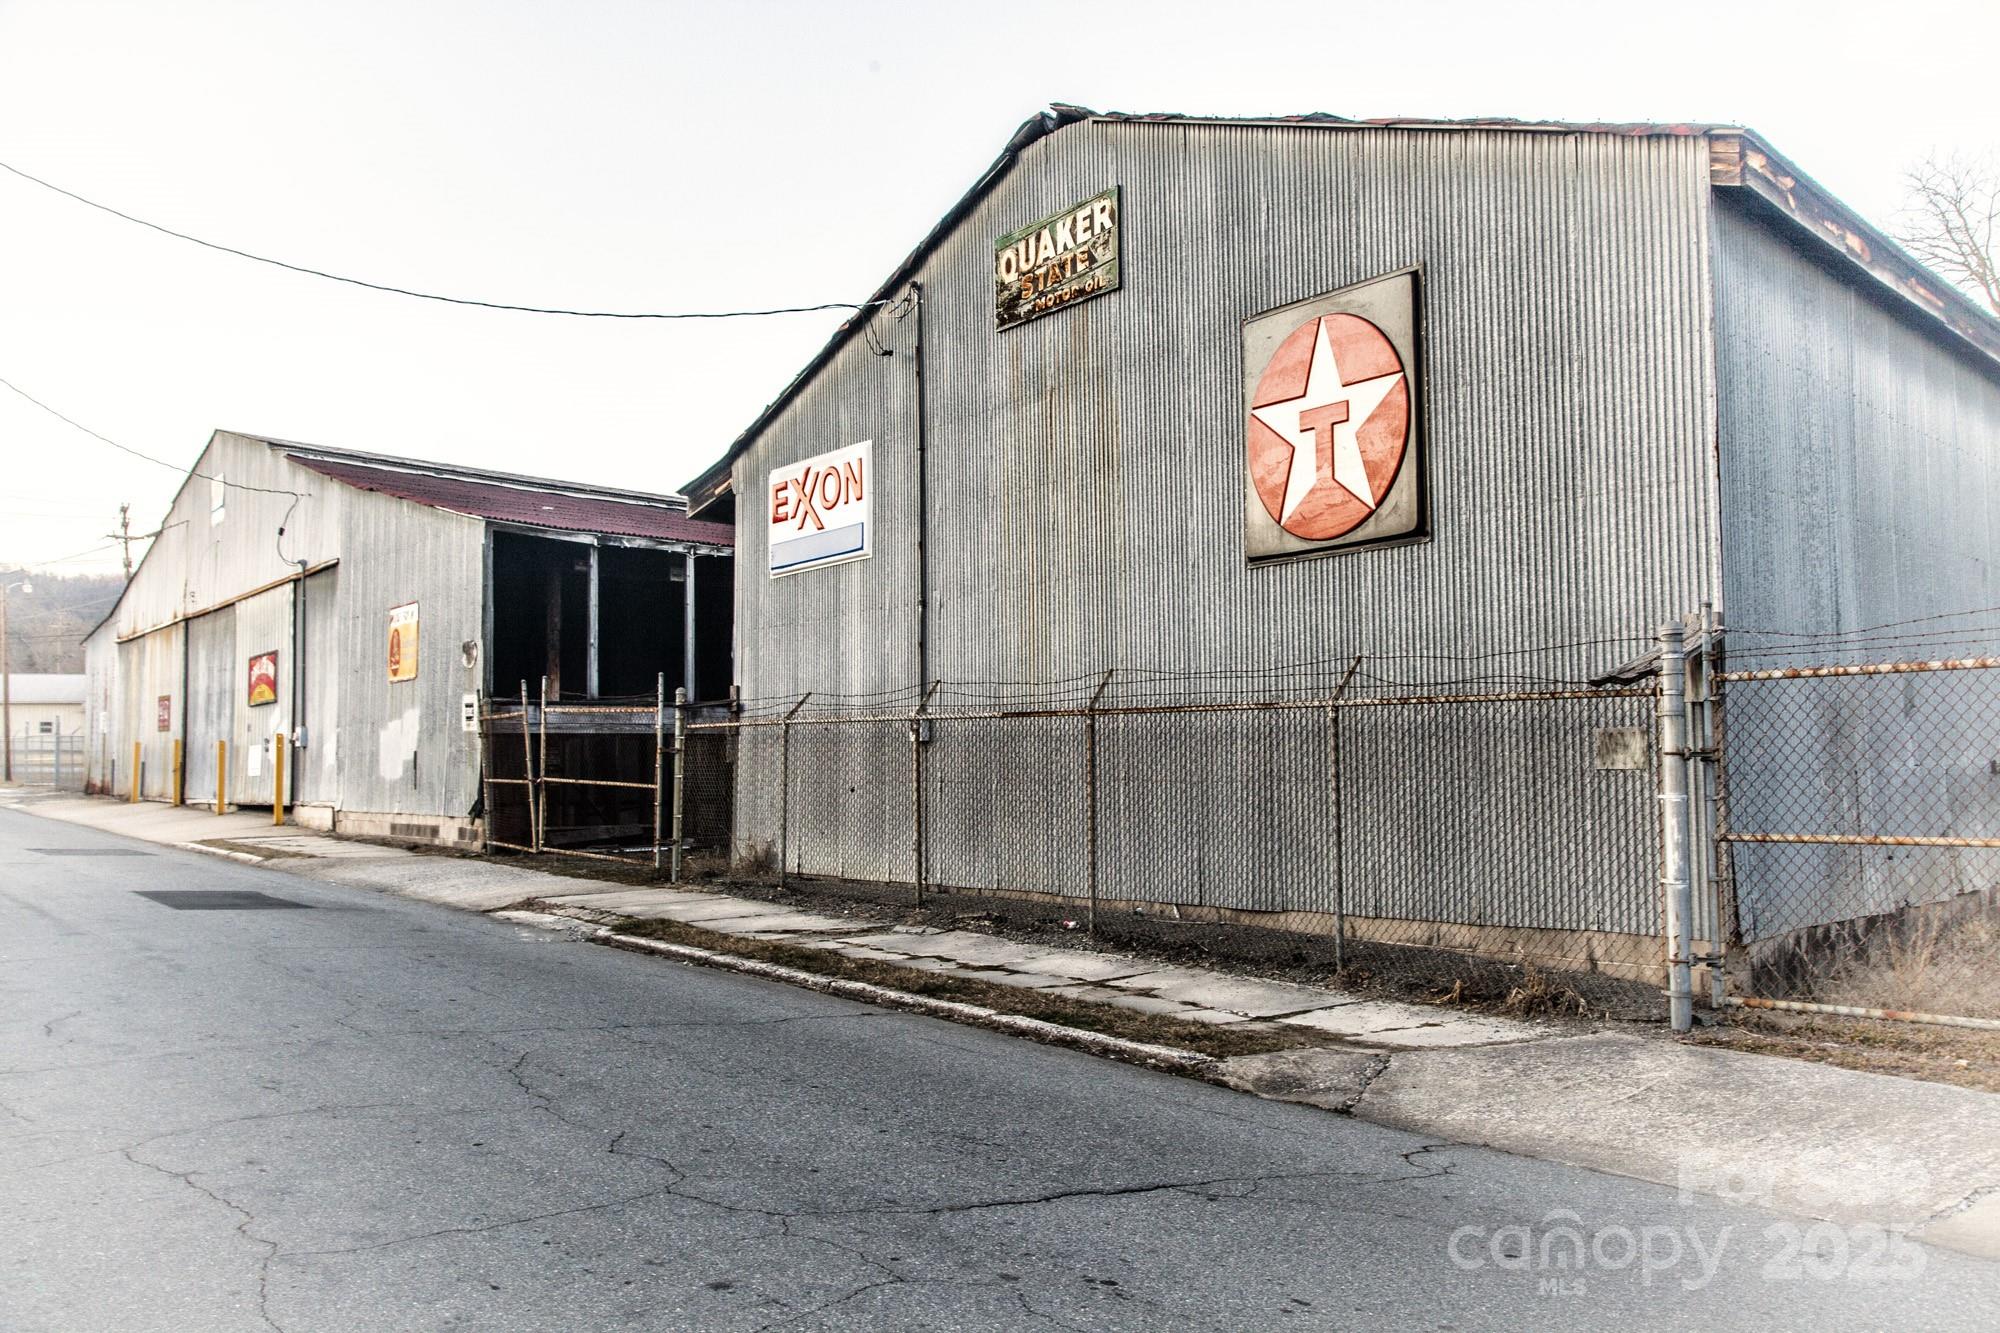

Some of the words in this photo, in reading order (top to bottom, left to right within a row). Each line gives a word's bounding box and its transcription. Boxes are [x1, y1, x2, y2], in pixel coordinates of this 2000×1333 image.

[1000, 197, 1114, 285] QUAKER
[1021, 245, 1090, 299] STATE
[1035, 285, 1080, 312] MOTOR
[1085, 275, 1107, 293] OIL
[1300, 400, 1349, 483] T
[772, 457, 863, 531] EXXON
